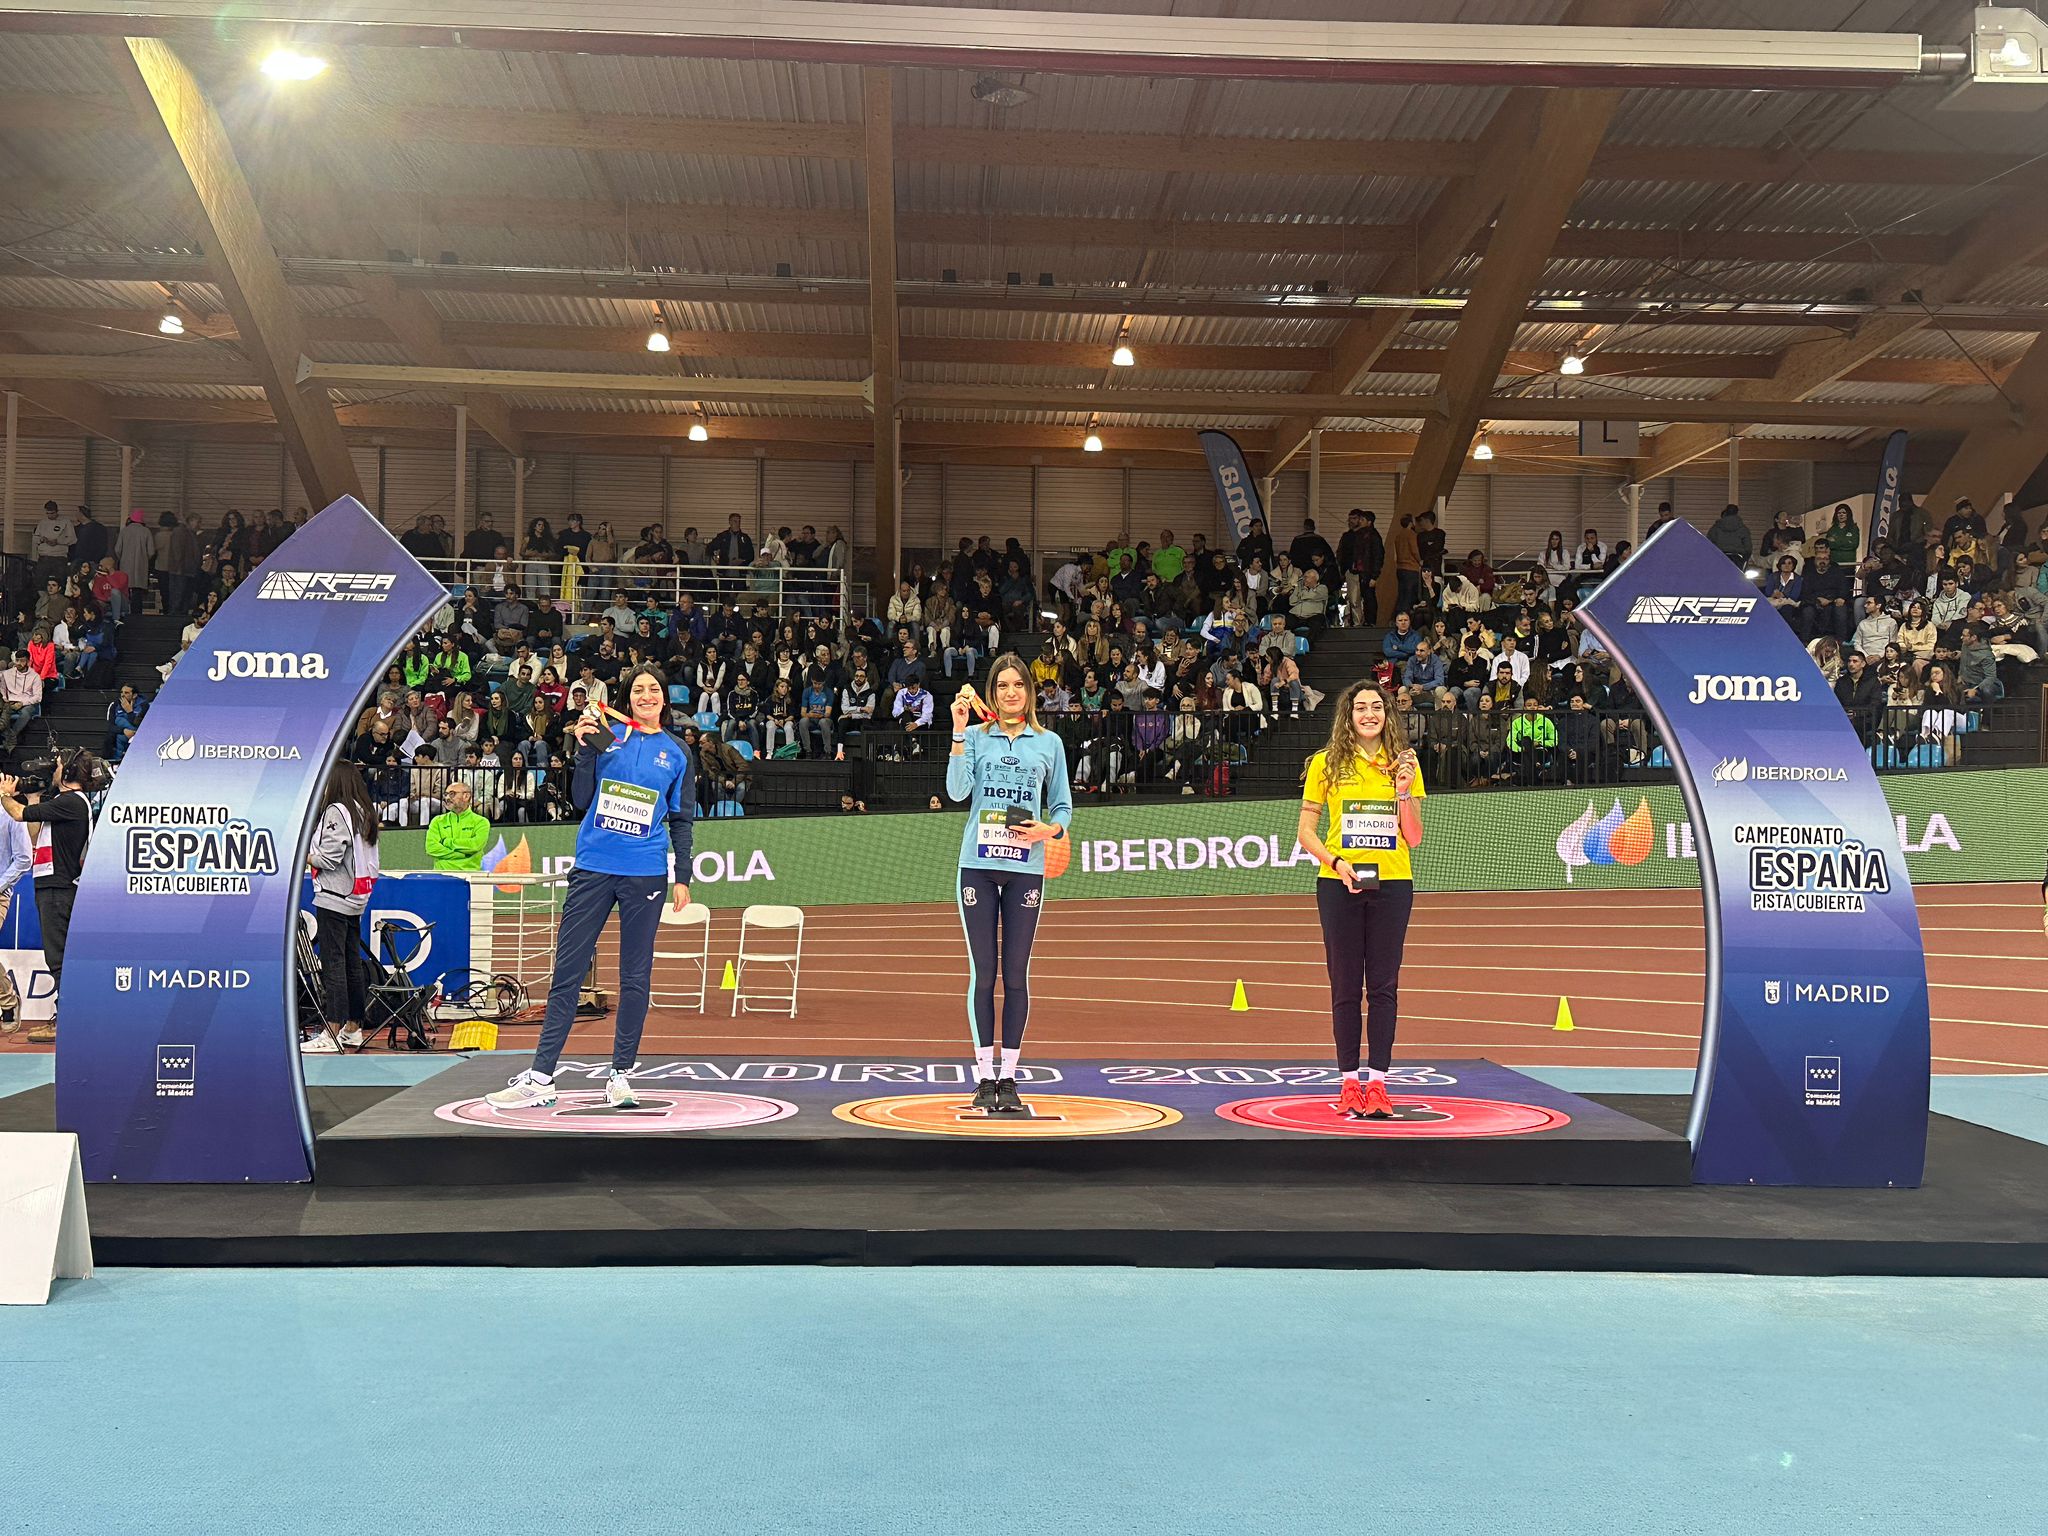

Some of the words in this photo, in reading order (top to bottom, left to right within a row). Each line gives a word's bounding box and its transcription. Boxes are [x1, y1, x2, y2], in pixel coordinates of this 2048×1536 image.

[1877, 466, 1900, 538] oma
[307, 571, 397, 590] RFEA
[303, 591, 388, 602] ATLETISMO
[1674, 596, 1757, 616] RFEA
[1670, 615, 1750, 625] ATLETISMO
[199, 744, 302, 760] IBERDROLA
[1752, 766, 1848, 781] IBERDROLA
[984, 786, 1034, 804] nerja
[110, 805, 229, 825] CAMPEONATO
[613, 802, 649, 817] MADRID
[1358, 820, 1394, 829] MADRID
[1734, 826, 1844, 845] CAMPEONATO
[131, 824, 273, 870] ESPAÑA
[1755, 844, 1887, 891] ESPAÑA
[129, 876, 172, 892] PISTA
[176, 877, 248, 892] CUBIERTA
[1753, 893, 1793, 910] PISTA
[1796, 894, 1863, 911] CUBIERTA
[148, 969, 251, 988] MADRID
[1795, 983, 1890, 1003] MADRID
